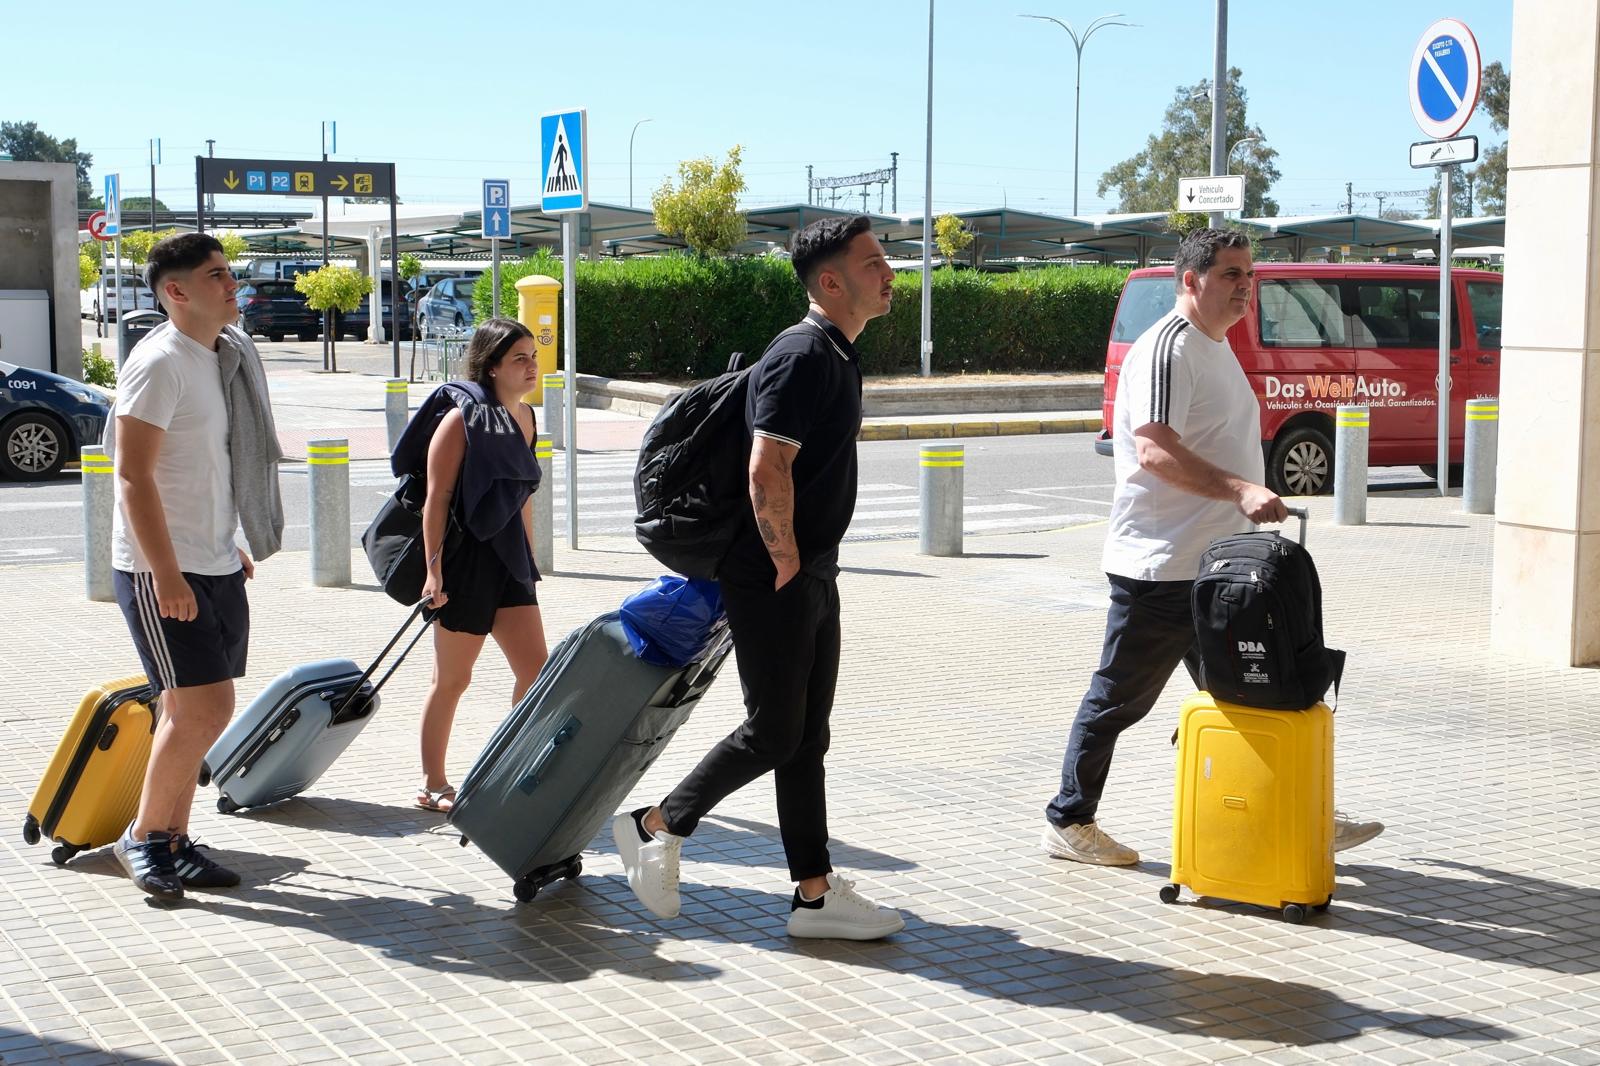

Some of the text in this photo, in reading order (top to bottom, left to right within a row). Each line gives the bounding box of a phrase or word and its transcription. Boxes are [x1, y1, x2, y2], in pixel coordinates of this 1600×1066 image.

[249, 175, 288, 188] P1 P2
[1199, 194, 1234, 204] Concertado
[1265, 376, 1305, 398] Das
[1304, 400, 1313, 409] de
[1238, 641, 1266, 652] DBA
